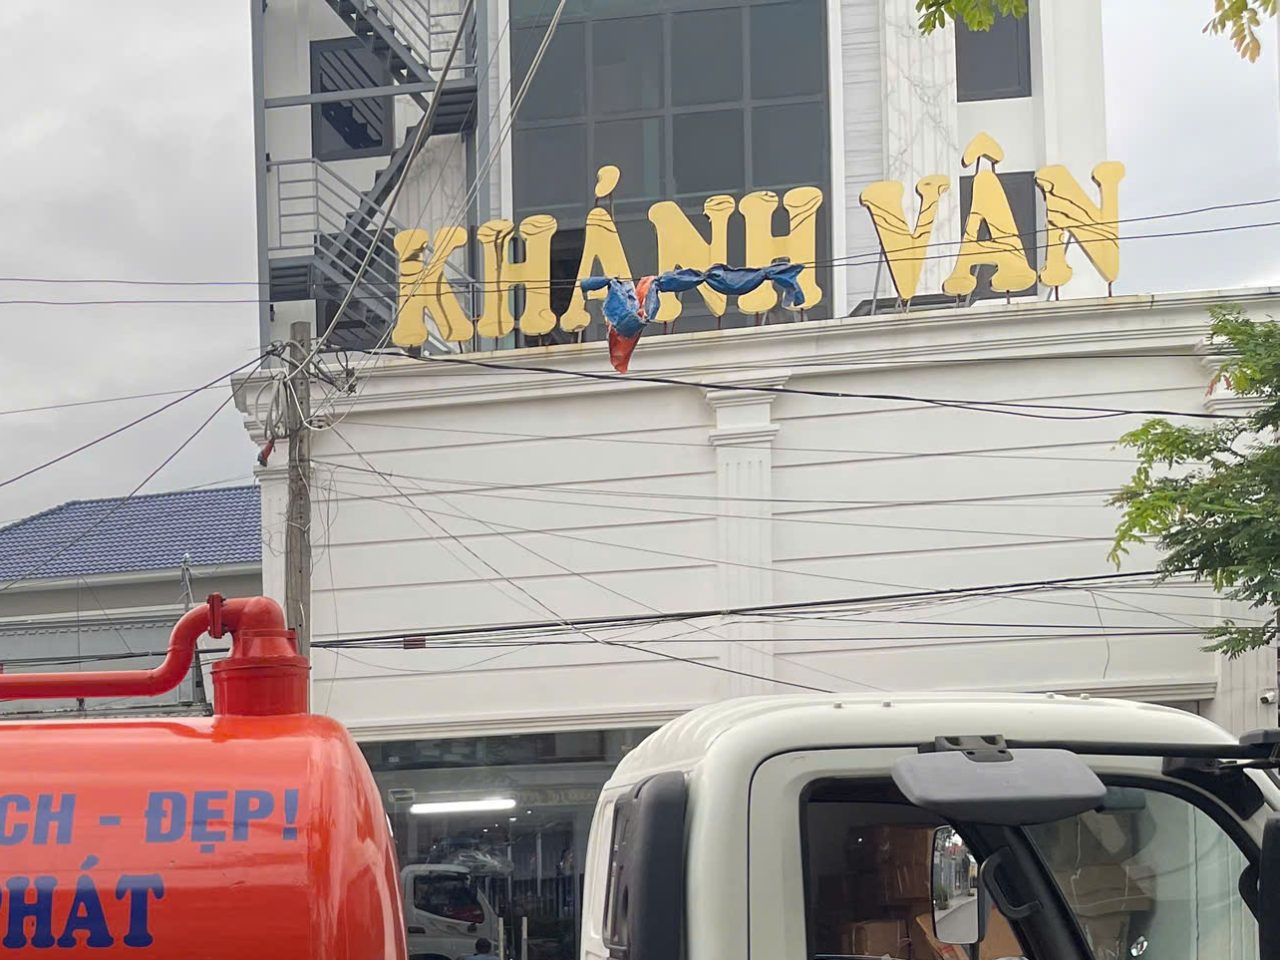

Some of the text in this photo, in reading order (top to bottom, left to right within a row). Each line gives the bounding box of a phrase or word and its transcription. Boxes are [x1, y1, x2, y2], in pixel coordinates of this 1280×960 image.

[391, 131, 1125, 347] KHÁNH VÂN
[144, 788, 300, 854] ĐẸP!
